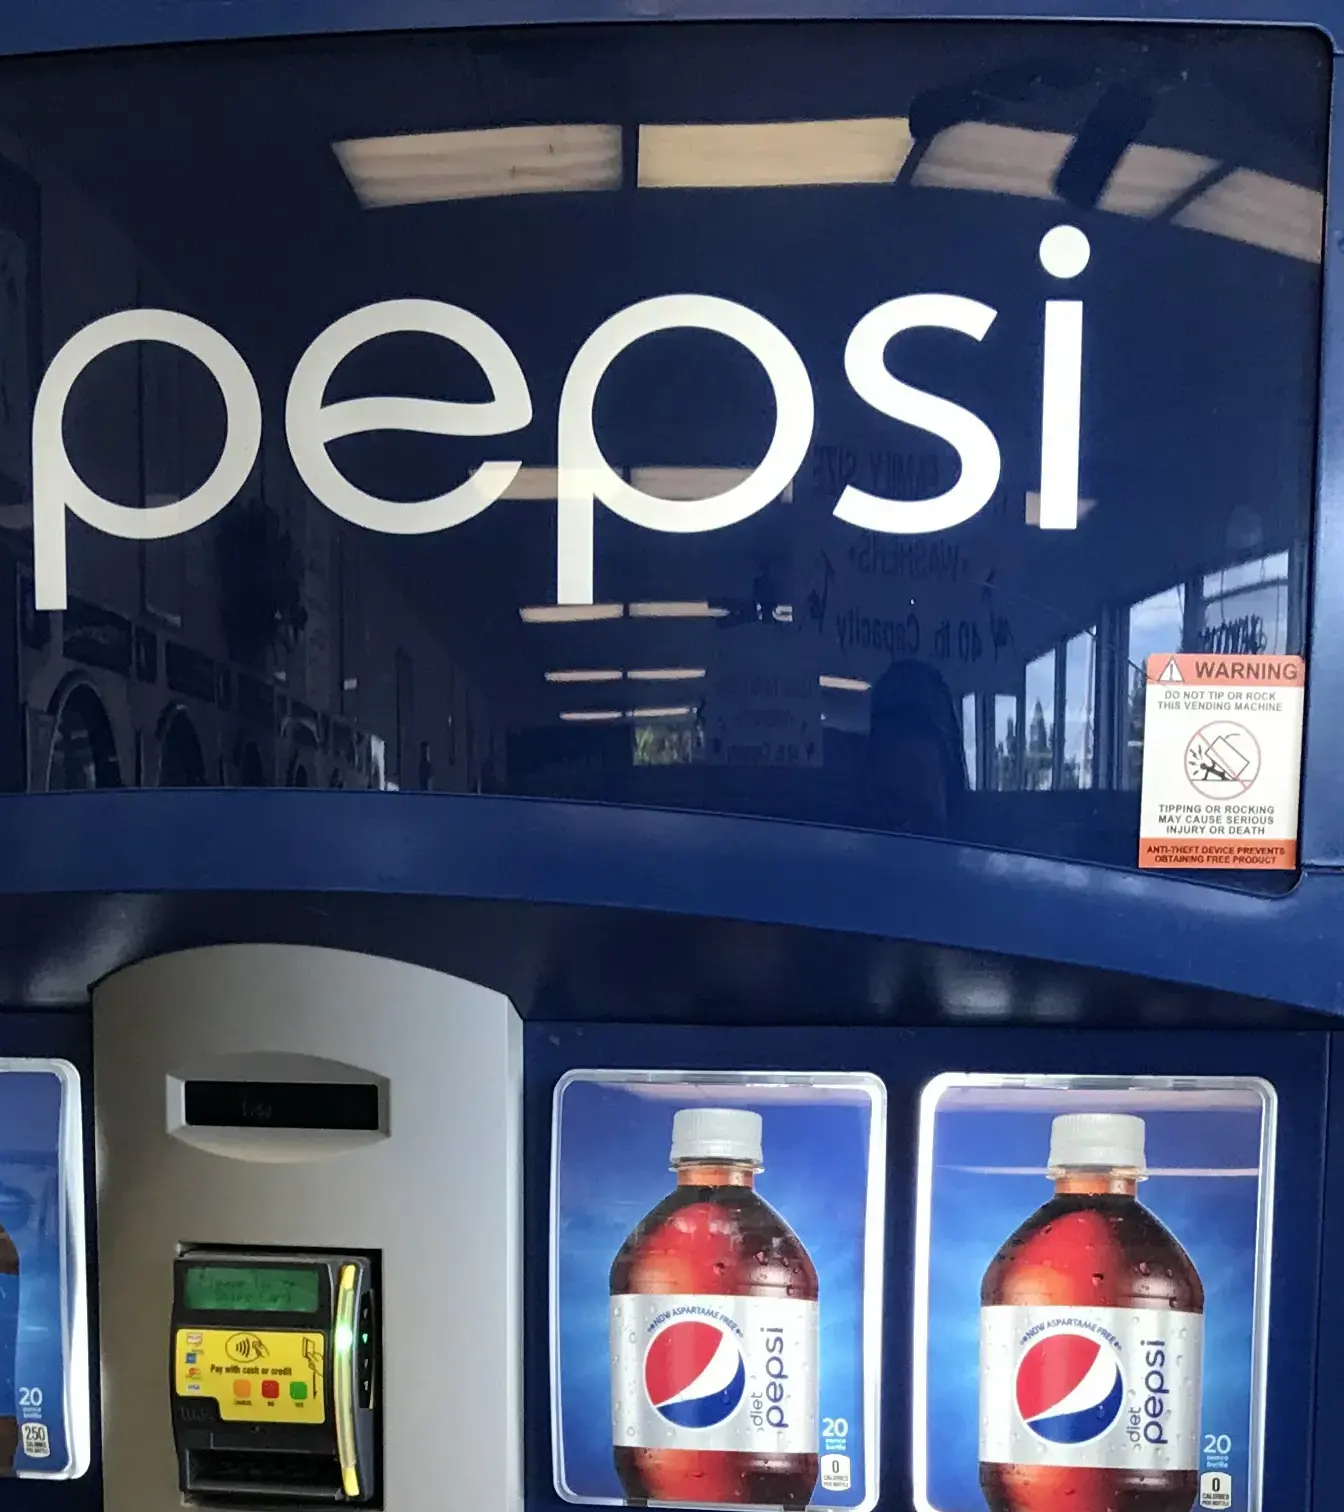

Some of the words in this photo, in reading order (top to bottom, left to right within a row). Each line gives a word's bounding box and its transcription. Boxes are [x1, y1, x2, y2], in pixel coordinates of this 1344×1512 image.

[32, 225, 1090, 611] pepsi
[1196, 662, 1298, 679] WARNING
[1165, 691, 1180, 700] DO
[1184, 691, 1204, 700] NOT
[1208, 691, 1223, 700] TIP
[1227, 691, 1243, 700] OR
[1246, 692, 1276, 700] ROCK
[1158, 701, 1180, 710] THIS
[1185, 702, 1230, 711] VENDING
[1235, 702, 1282, 711] MACHINE
[1159, 804, 1201, 813] TIPPING
[1205, 805, 1221, 814] OR
[1225, 805, 1274, 814] ROCKING
[1159, 815, 1181, 824] MAY
[1185, 815, 1222, 824] CAUSE
[1226, 815, 1274, 825] SERIOUS
[1167, 826, 1205, 835] INJURY
[1209, 826, 1225, 835] OR
[1229, 826, 1265, 835] DEATH
[1147, 846, 1199, 854] ANTI-THEFT
[1202, 846, 1234, 855] DEVICE
[1237, 847, 1285, 855] PREVENTS
[1155, 855, 1204, 863] OBTAINING
[1207, 855, 1230, 863] FREE
[1233, 856, 1276, 864] PRODUCT
[653, 1311, 671, 1326] NOW
[672, 1306, 719, 1319] ASPARTAME
[1026, 1323, 1045, 1339] NOW
[1046, 1318, 1097, 1332] ASPARTAME
[1097, 1327, 1116, 1344] FREE
[211, 1365, 223, 1375] Pay
[225, 1365, 241, 1375] with
[243, 1366, 259, 1375] cash
[271, 1366, 292, 1376] credit
[761, 1327, 789, 1428] pepsi
[19, 1387, 43, 1405] 20
[1140, 1339, 1171, 1445] pepsi
[750, 1392, 764, 1427] diet
[822, 1418, 848, 1437] 20
[1128, 1406, 1141, 1442] diet
[25, 1426, 45, 1440] 250
[1204, 1434, 1231, 1453] 20
[832, 1460, 839, 1473] 0
[1212, 1478, 1220, 1492] 0
